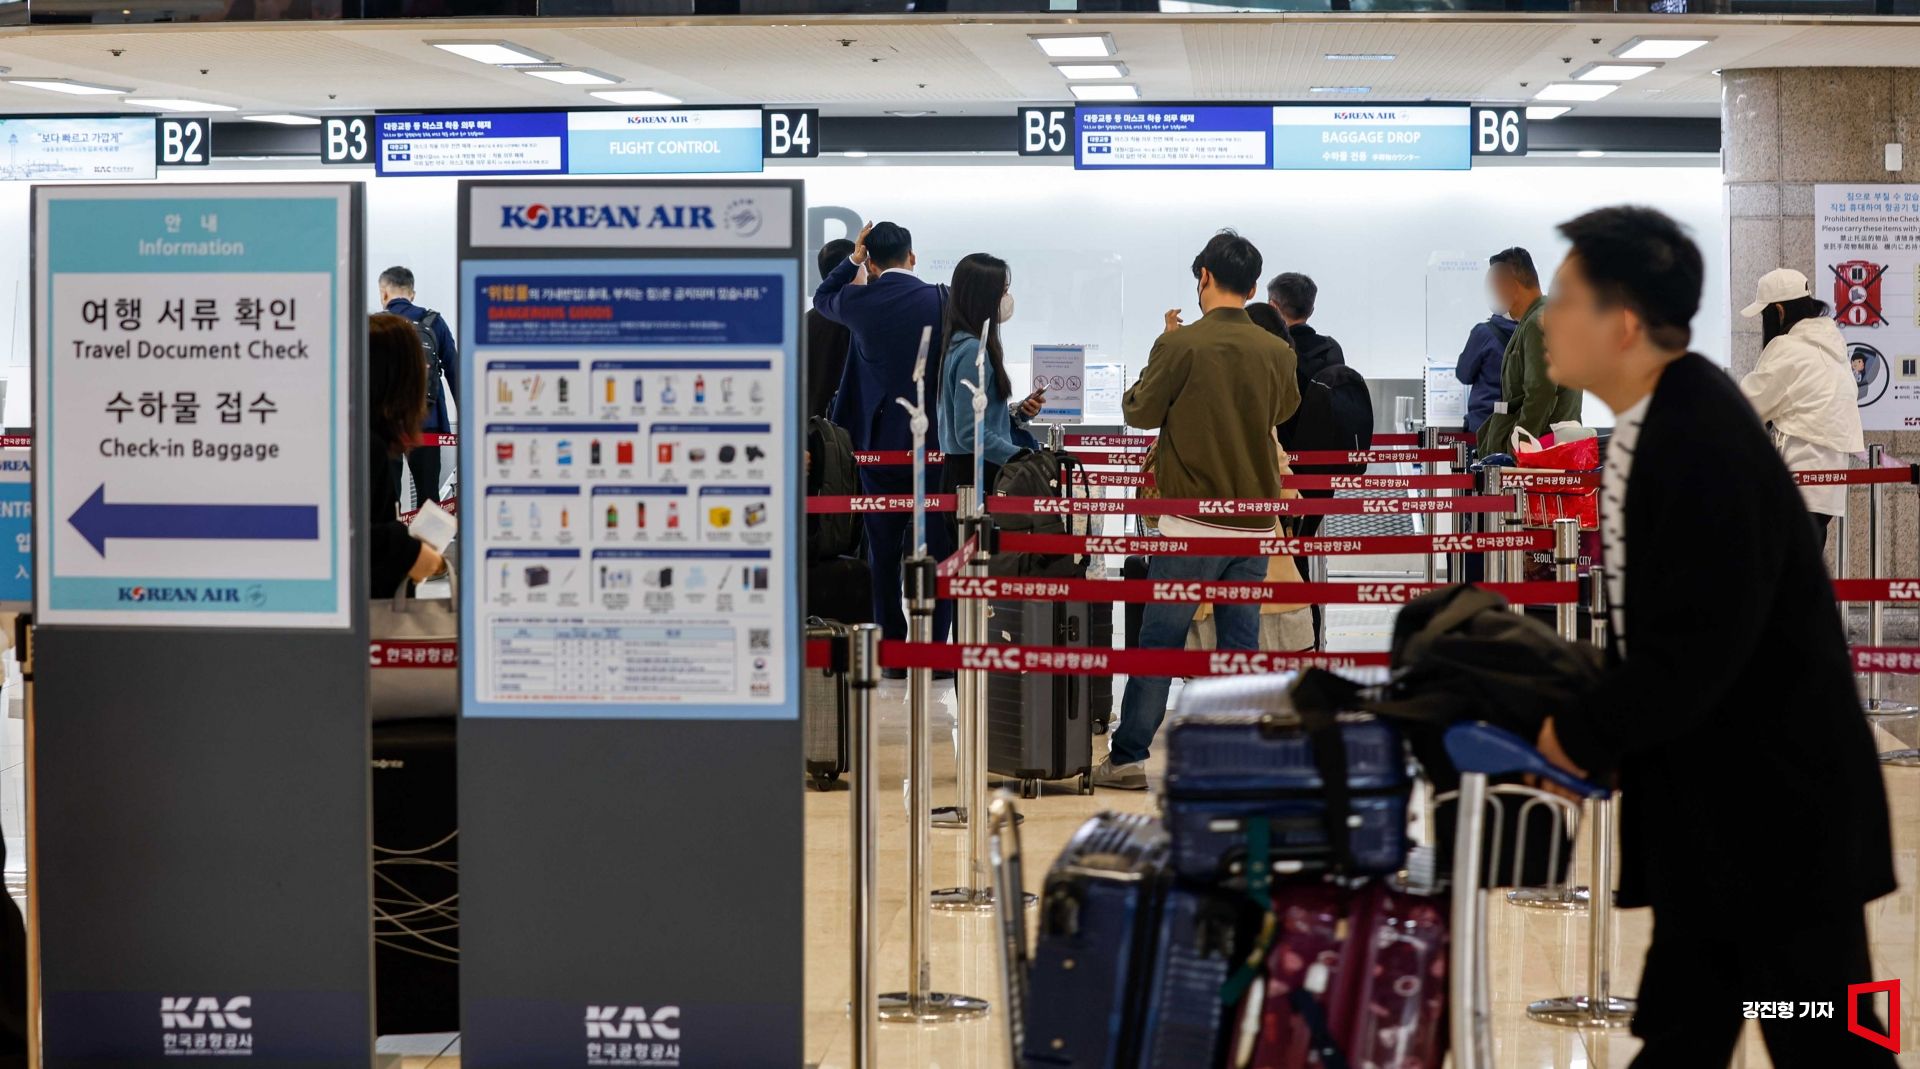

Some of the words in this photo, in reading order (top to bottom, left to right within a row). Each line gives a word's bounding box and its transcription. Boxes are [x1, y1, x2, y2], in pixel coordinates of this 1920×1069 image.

[628, 116, 667, 124] KOREAN
[1084, 114, 1112, 123] 대중교통
[1124, 114, 1145, 122] 마스크
[1147, 114, 1161, 122] 착용
[1164, 114, 1178, 122] 의무
[1180, 114, 1194, 122] 해제
[1334, 112, 1376, 120] KOREAN
[1377, 112, 1396, 120] AIR
[384, 122, 411, 131] 대중교통
[422, 121, 444, 130] 마스크
[445, 121, 459, 130] 착용
[461, 120, 475, 130] 의무
[477, 120, 492, 130] 해제
[1025, 111, 1066, 152] B5
[1479, 110, 1519, 152] B6
[62, 132, 89, 143] 빠르고
[163, 121, 203, 162] B2
[327, 119, 368, 160] B3
[770, 114, 810, 154] B4
[1322, 131, 1384, 144] BAGGAGE
[1387, 131, 1421, 143] DROP
[610, 141, 654, 154] FLIGHT
[658, 140, 720, 154] CONTROL
[1322, 152, 1348, 162] 수하물
[1847, 192, 1870, 201] 짐으로
[1874, 192, 1890, 201] 부칠
[1893, 192, 1901, 200] 수
[1830, 203, 1846, 212] 직접
[1850, 203, 1882, 212] 휴대하여
[1885, 203, 1908, 212] 항공기
[500, 203, 640, 230] KOREAN
[648, 204, 716, 230] AIR
[138, 239, 244, 256] Information
[82, 298, 142, 331] 여행
[157, 298, 221, 331] 서류
[234, 298, 297, 331] 확인
[73, 340, 130, 359] Travel
[138, 340, 241, 360] Document
[248, 340, 309, 359] Check
[104, 391, 201, 424] 수하물
[216, 391, 278, 424] 접수
[1080, 436, 1106, 446] KAC
[1108, 436, 1145, 445] 한국공항공사
[99, 438, 184, 458] Check-in
[193, 439, 280, 461] Baggage
[1348, 452, 1376, 462] KAC
[1378, 452, 1418, 461] 한국공항공사
[1108, 454, 1136, 464] KAC
[1101, 475, 1145, 485] 한국공항공사
[1330, 476, 1362, 488] KAC
[1364, 478, 1409, 487] 한국공항공사
[1502, 475, 1533, 486] KAC
[1536, 476, 1581, 485] 한국공항공사
[1802, 473, 1847, 483] 한국공항공사
[850, 497, 886, 510] KAC
[889, 498, 940, 508] 한국공공사
[1034, 499, 1070, 513] KAC
[1073, 501, 1124, 512] 한국공항공사
[1199, 500, 1235, 514] KAC
[1238, 502, 1289, 512] 한국공항공사
[1363, 499, 1398, 512] KAC
[1402, 501, 1453, 510] 한국공항공사
[1085, 537, 1127, 553] KAC
[1130, 540, 1188, 552] 한국공항공사
[1259, 539, 1300, 554] KAC
[1304, 541, 1362, 552] 한국공항공사
[1432, 535, 1473, 551] KAC
[1476, 536, 1534, 548] 한국공항공사
[1534, 552, 1552, 563] SEOUL
[1579, 556, 1592, 566] CITY
[118, 586, 198, 603] KOREAN
[202, 587, 240, 602] AIR
[950, 579, 997, 596] KAC
[1001, 582, 1070, 596] 한국공항공사
[1154, 583, 1201, 600] KAC
[1205, 586, 1273, 600] 한국공항공사
[1357, 585, 1405, 602] KAC
[962, 647, 1021, 668] KAC
[1025, 652, 1107, 669] 한국공항공사
[1209, 653, 1268, 674] KAC
[160, 995, 253, 1030] KAC
[584, 1006, 680, 1040] KAC
[163, 1032, 253, 1049] 한국공항공사
[586, 1042, 680, 1060] 한국공항공사
